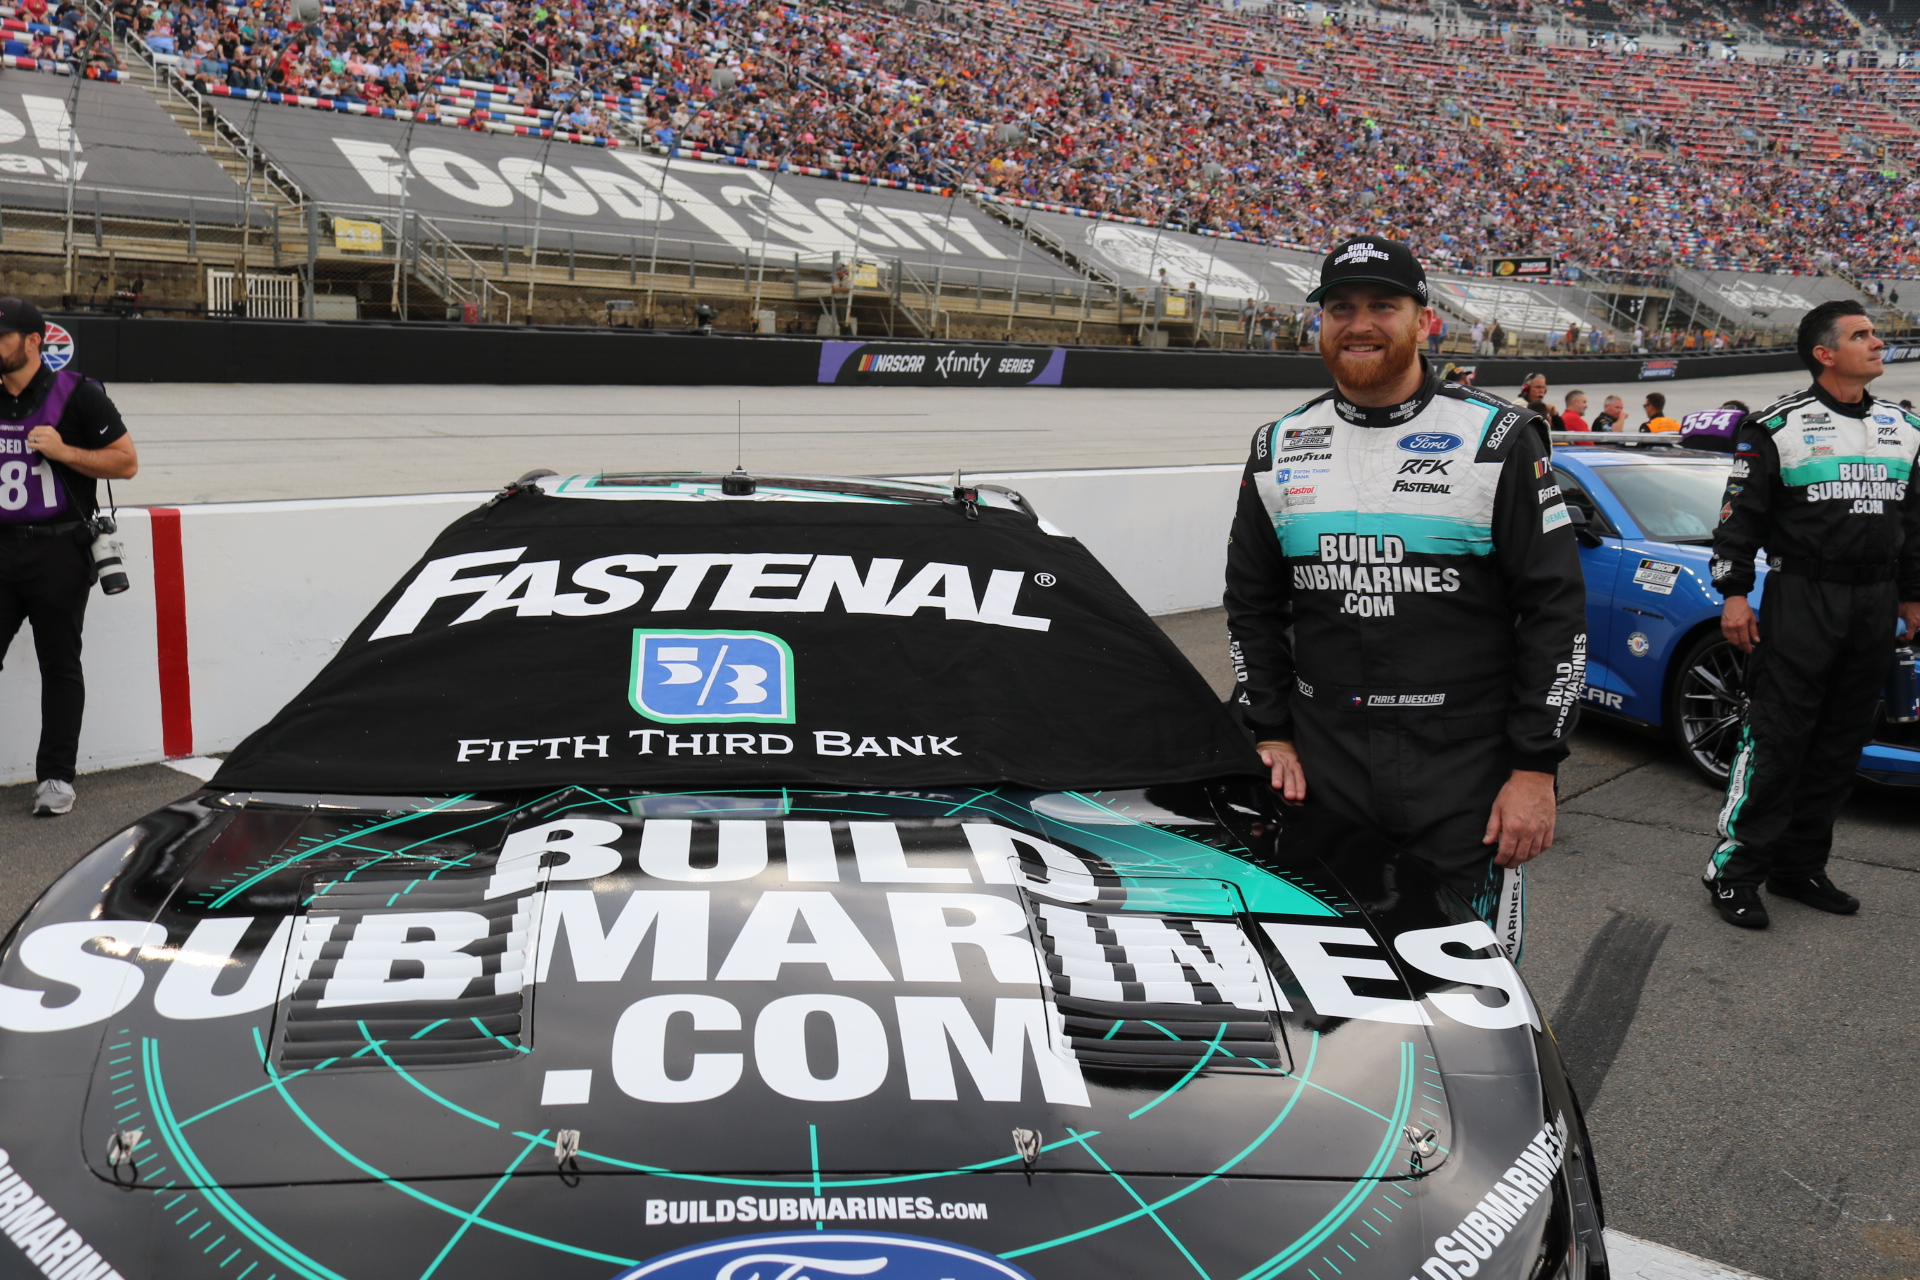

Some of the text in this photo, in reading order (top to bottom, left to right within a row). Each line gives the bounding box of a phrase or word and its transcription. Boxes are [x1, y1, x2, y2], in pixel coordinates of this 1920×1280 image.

[331, 138, 1012, 259] FOOD CITY
[1334, 250, 1389, 265] SUBMARINES
[1347, 243, 1374, 252] BUILD
[875, 350, 1036, 379] NASCAR xfinity SERIES
[1300, 428, 1327, 436] NASCAR
[1487, 411, 1518, 450] sparco
[1681, 412, 1735, 435] 554
[1409, 434, 1450, 450] Ford
[1278, 452, 1333, 463] GOODYEAR
[1397, 459, 1454, 475] RFK
[1839, 463, 1888, 481] BUILD
[0, 459, 58, 511] 81
[1289, 486, 1315, 495] Castrol
[1392, 480, 1452, 494] FASTENAL
[1807, 481, 1909, 502] SUBMARINS
[1849, 500, 1884, 514] .COM
[1319, 535, 1405, 564] BUILD
[1293, 564, 1461, 593] SUBMARINES
[1640, 571, 1671, 583] CUP SERIES
[1652, 562, 1676, 573] NASCAR
[368, 547, 1052, 642] FASTENAL
[1340, 592, 1395, 617] .COM
[1546, 662, 1573, 707] BUILD
[1552, 633, 1587, 738] SUBMARINES
[1367, 693, 1446, 706] CHRIS BUESCHER
[456, 729, 963, 763] FIFTH THIRD BANK
[484, 818, 1100, 901] BUILD
[0, 888, 1542, 1033] SUBMARINES
[541, 994, 1092, 1107] .COM
